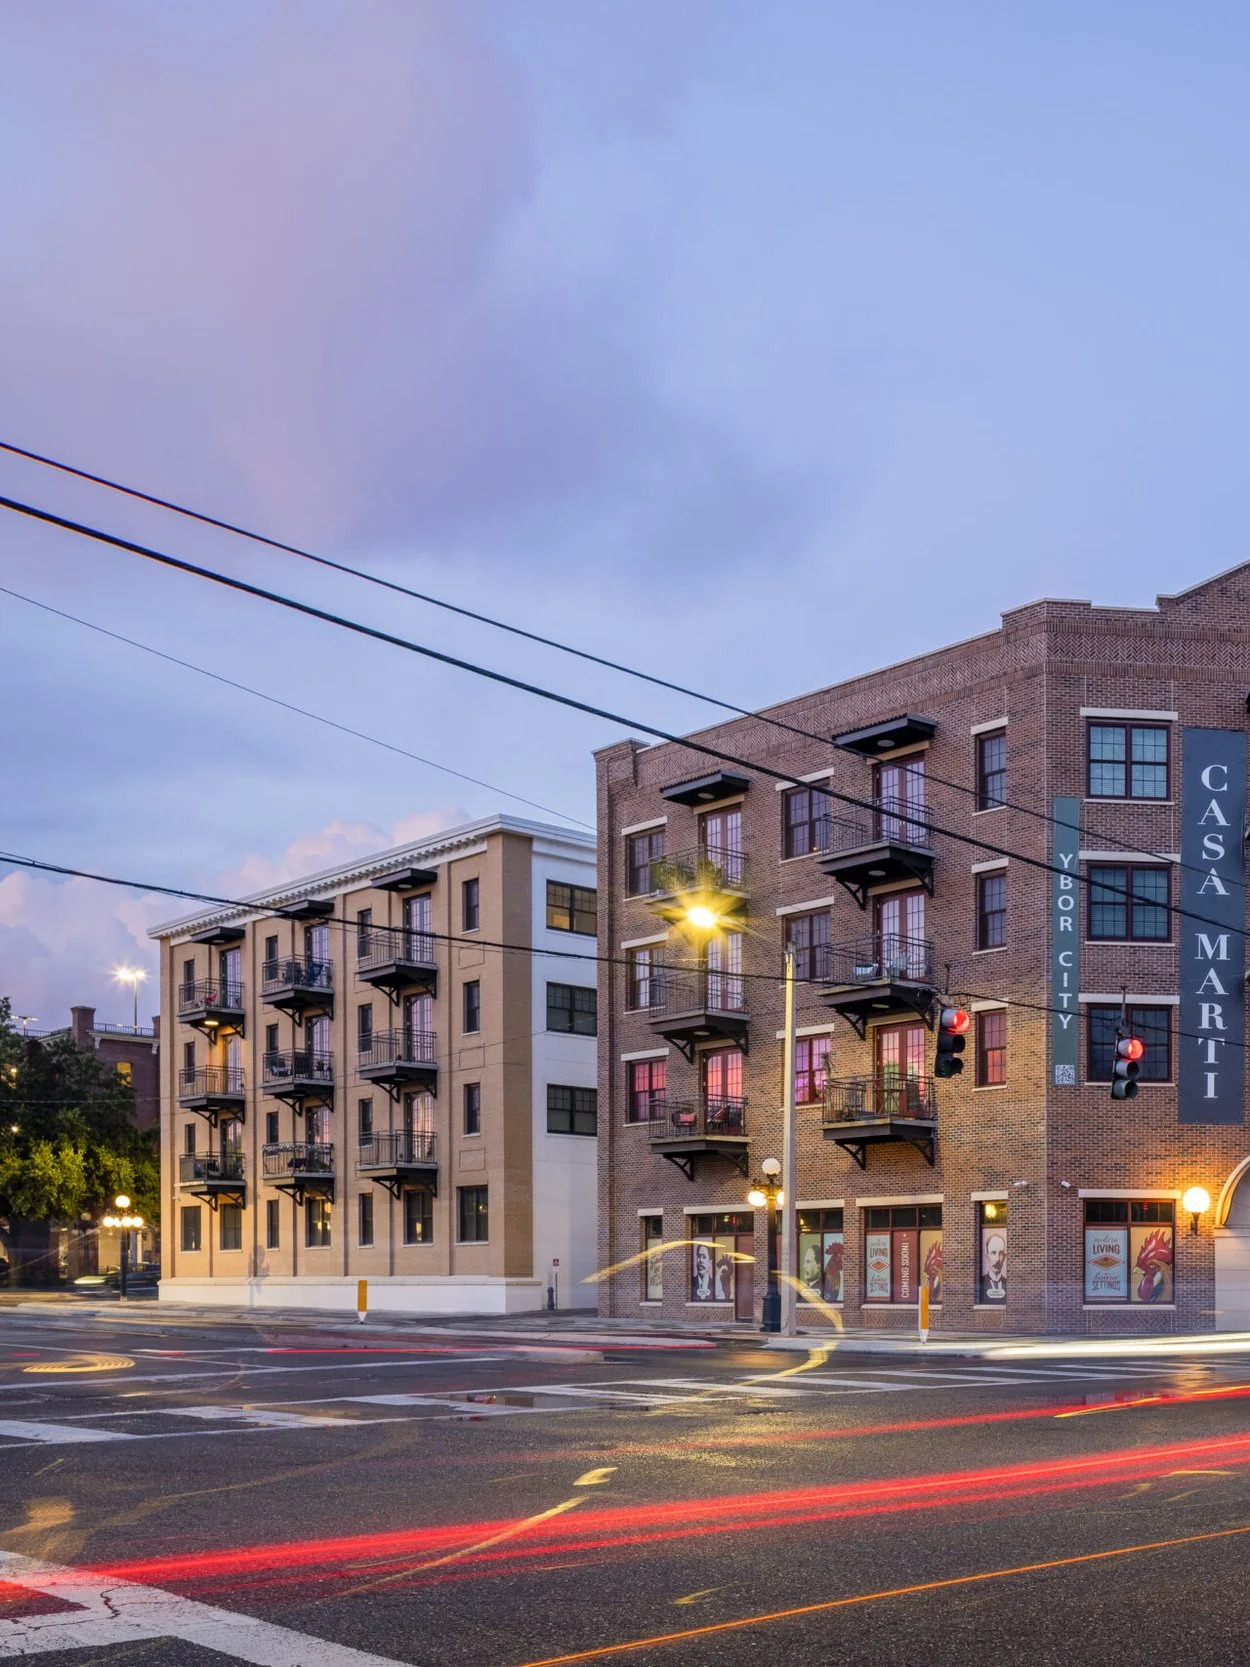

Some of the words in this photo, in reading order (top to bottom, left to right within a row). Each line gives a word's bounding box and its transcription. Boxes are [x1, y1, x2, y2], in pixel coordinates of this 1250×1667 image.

[1197, 764, 1231, 896] CASA
[1057, 853, 1074, 932] YBOR
[1058, 951, 1073, 1030] CITY
[1194, 933, 1231, 1099] MARTI
[870, 1247, 888, 1258] LIVING
[1093, 1244, 1120, 1255] LIVING
[869, 1283, 888, 1293] SETTINGS
[901, 1267, 909, 1297] COMING
[1092, 1281, 1120, 1291] SETTINGS
